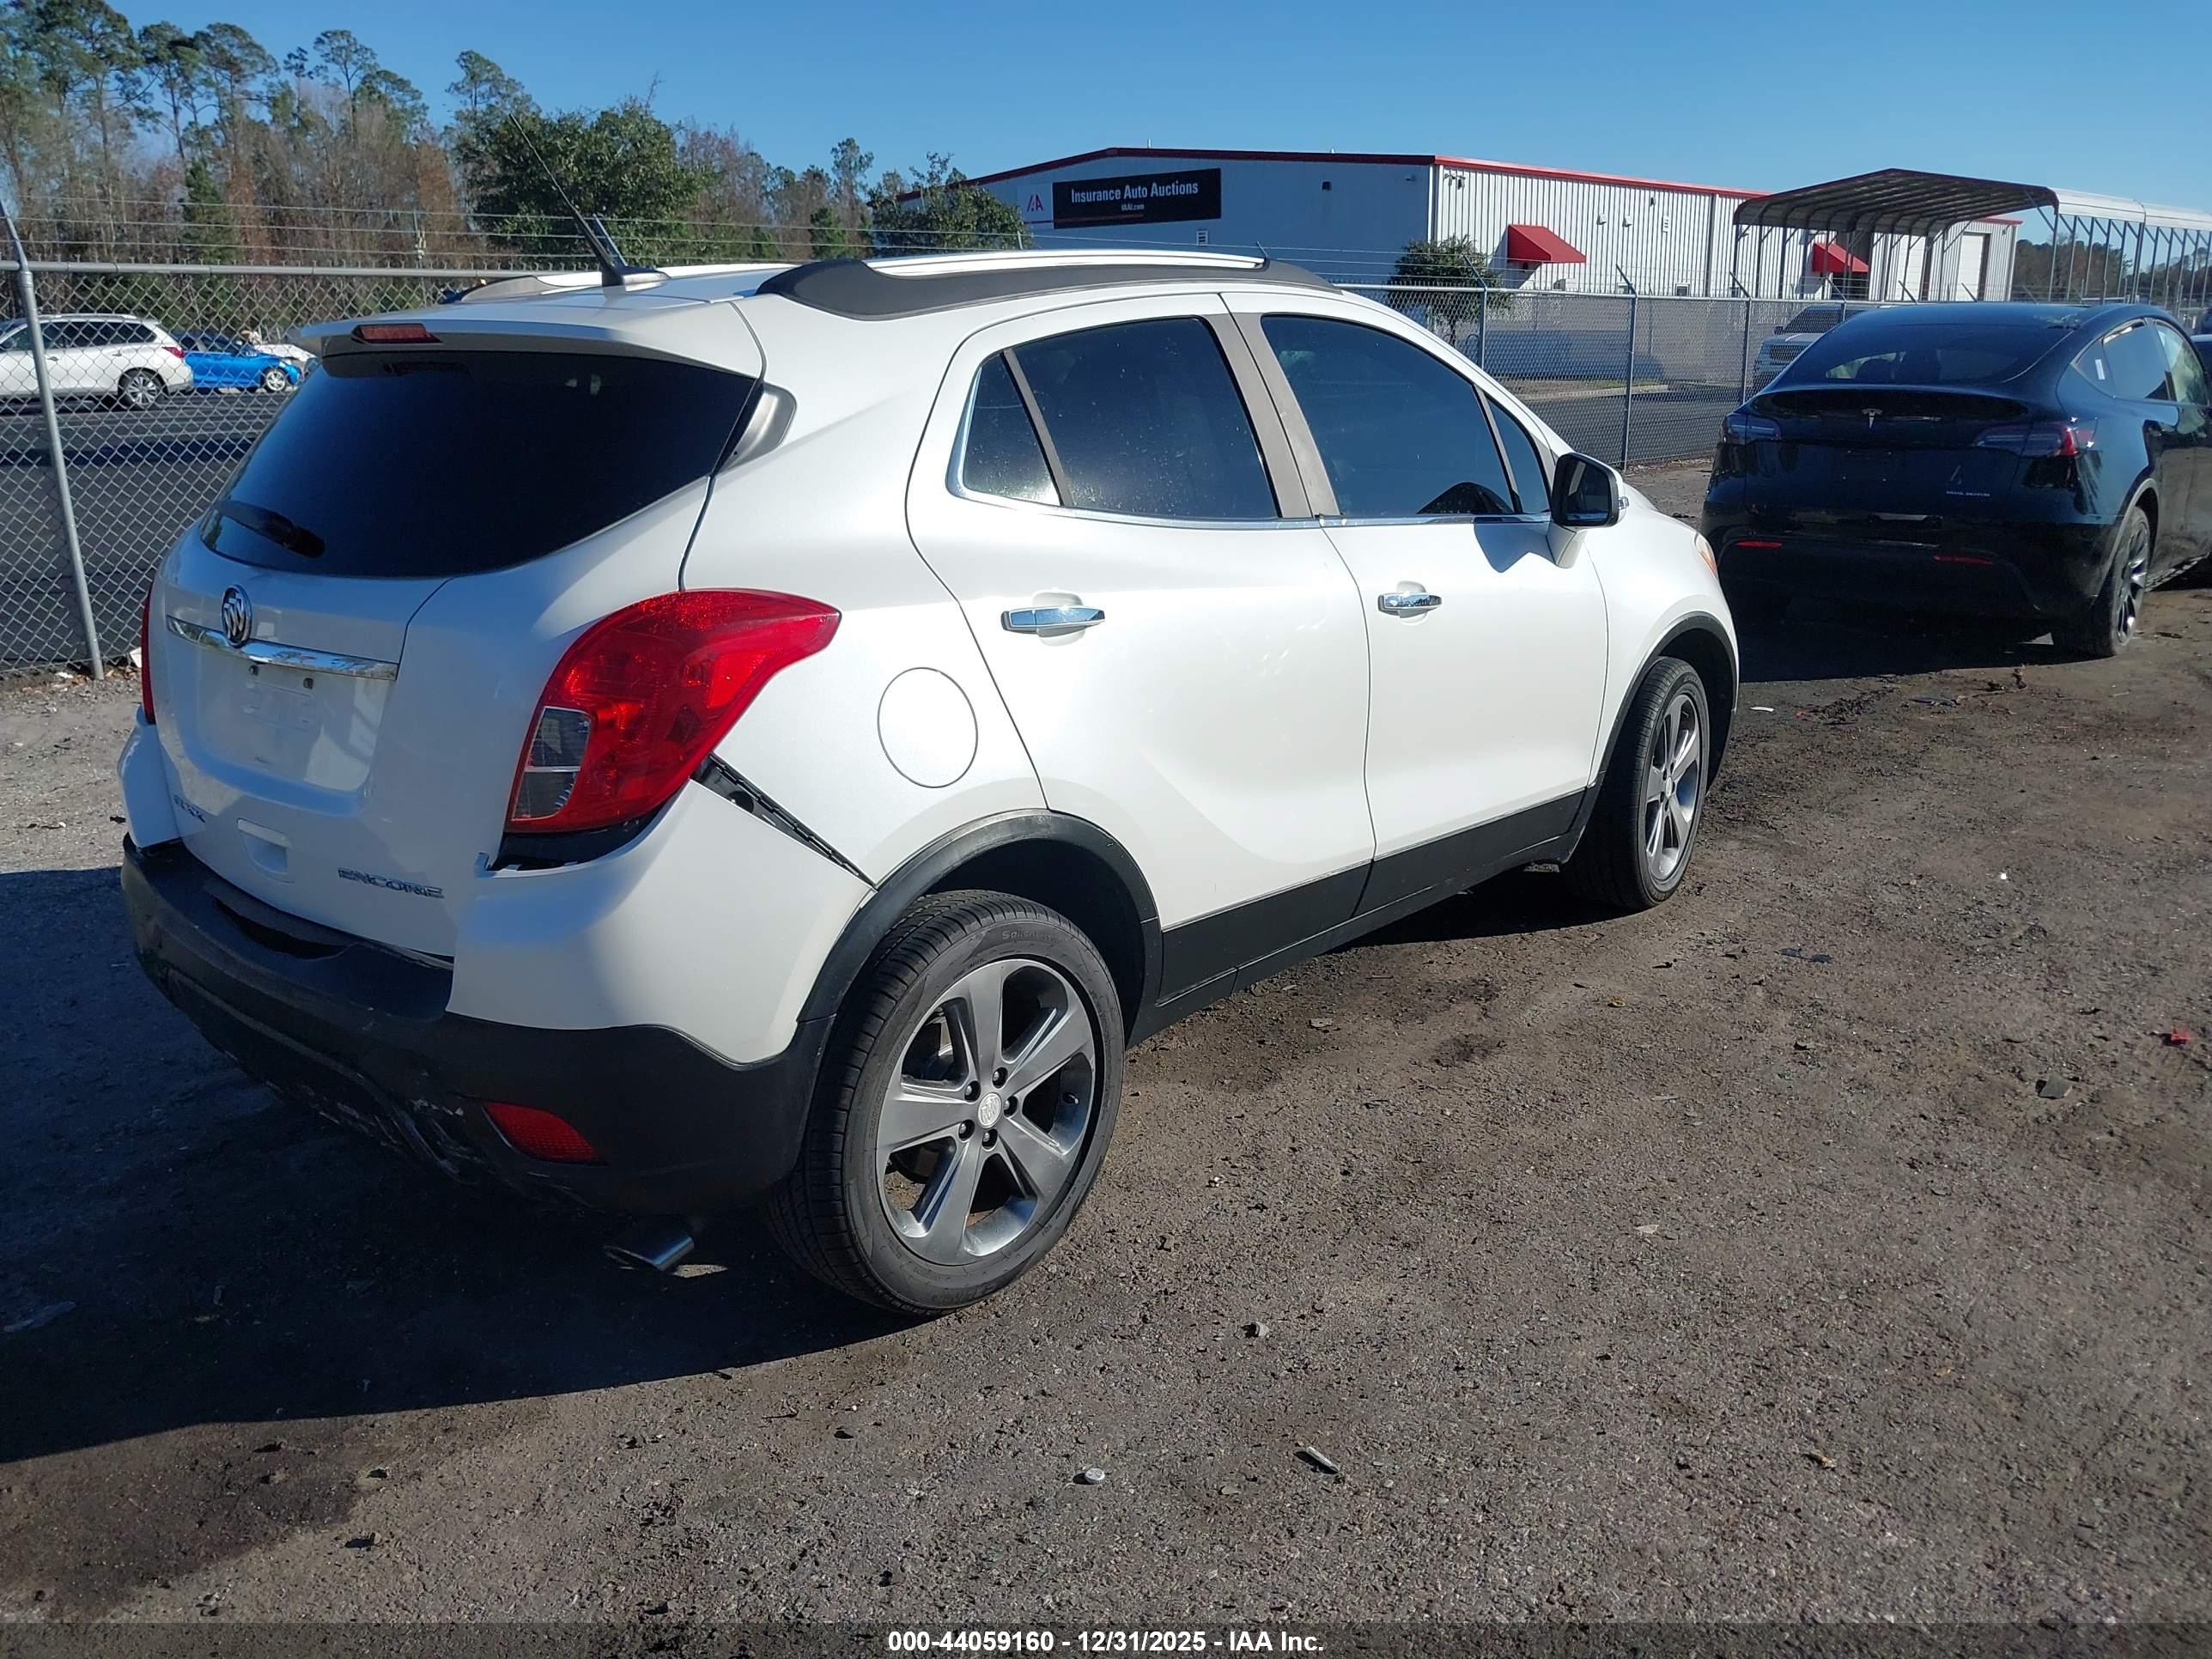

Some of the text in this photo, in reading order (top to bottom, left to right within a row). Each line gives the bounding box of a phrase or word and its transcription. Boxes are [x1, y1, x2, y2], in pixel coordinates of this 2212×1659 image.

[1071, 180, 1199, 204] Insurance Auto Auctions
[337, 867, 445, 899] ENCORE
